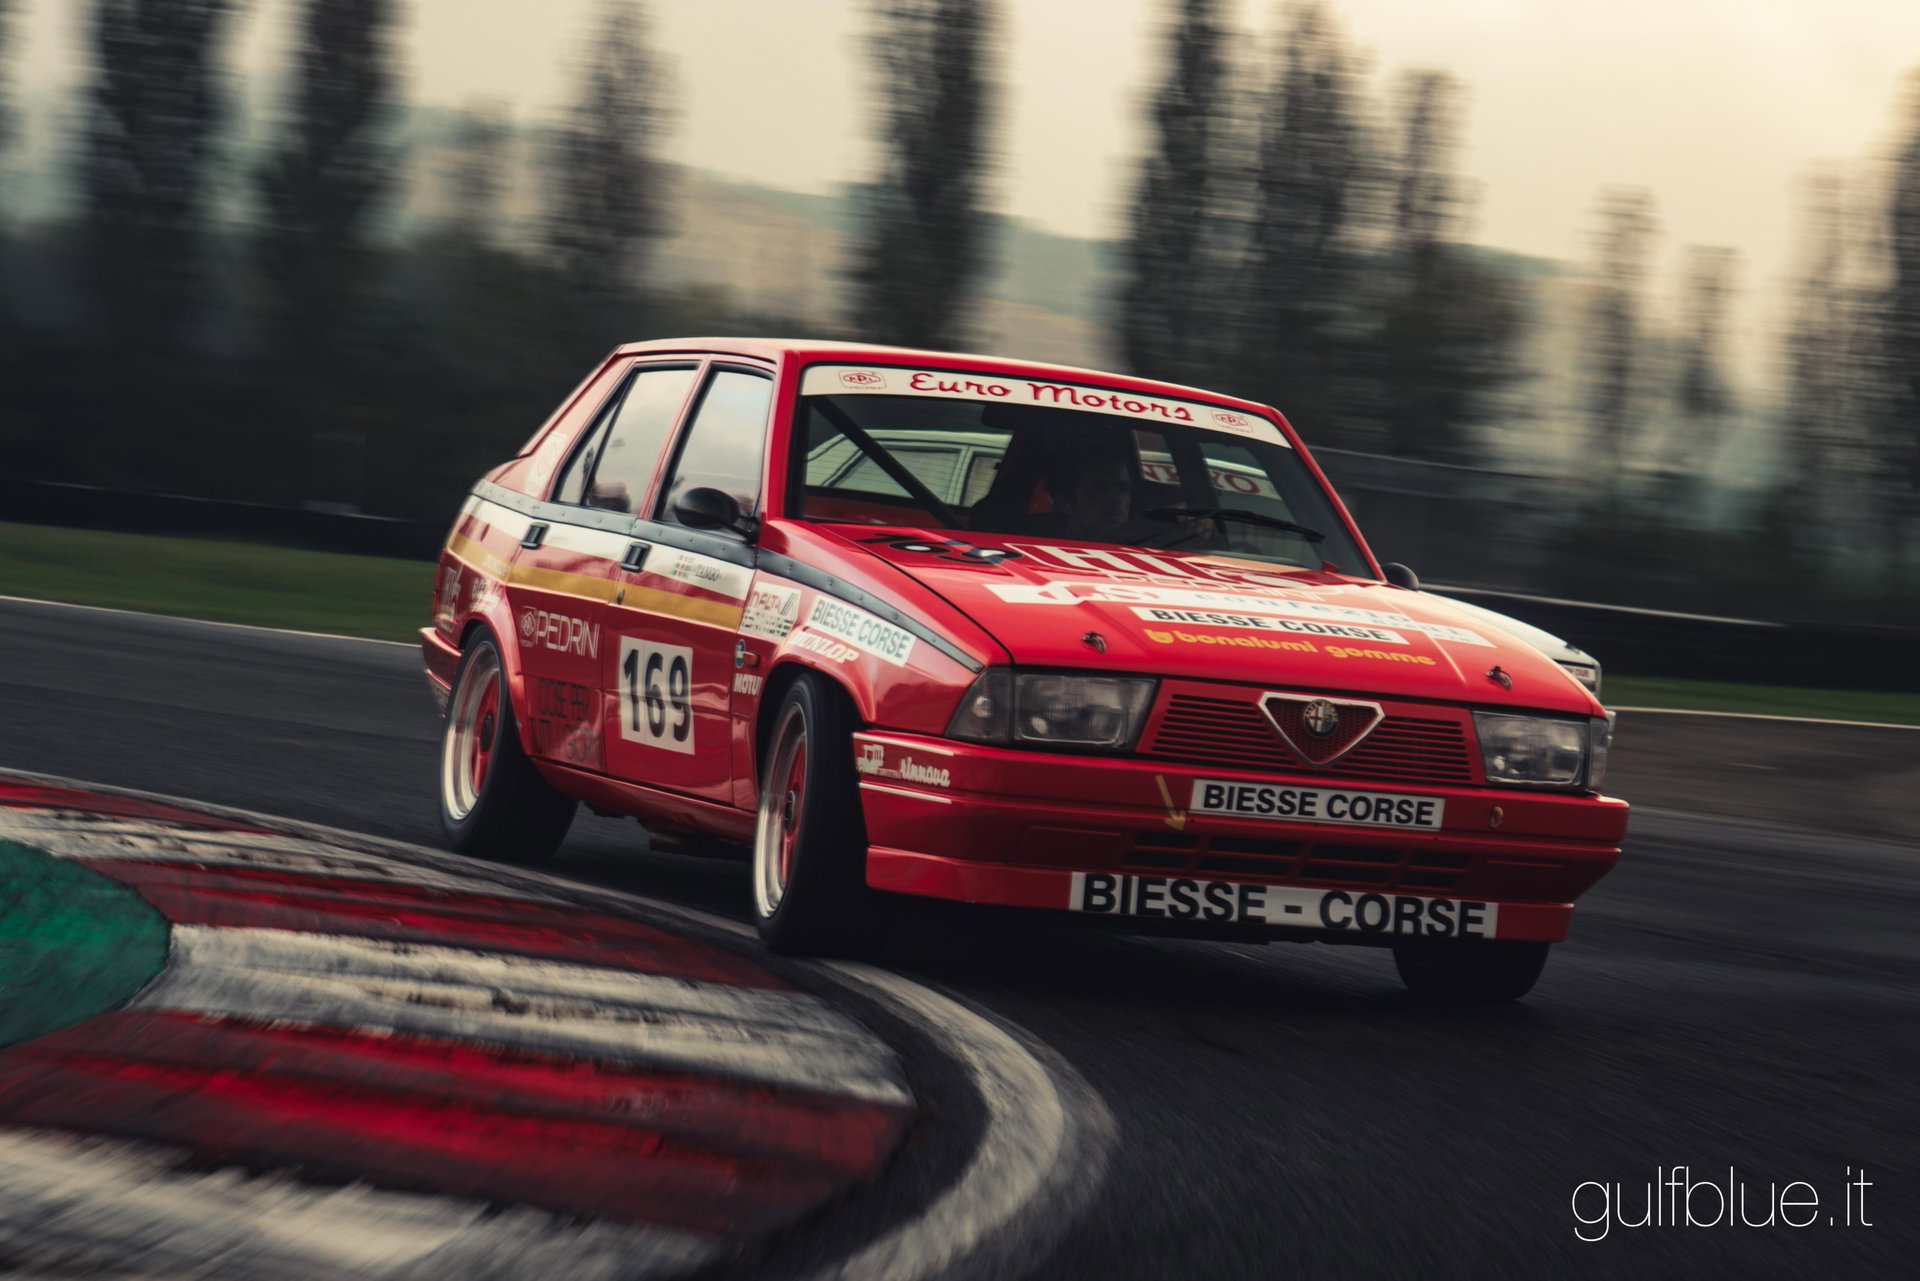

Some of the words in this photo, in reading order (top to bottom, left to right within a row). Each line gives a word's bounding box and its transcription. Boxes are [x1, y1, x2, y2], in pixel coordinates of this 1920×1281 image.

[909, 372, 1012, 397] Euro
[1027, 382, 1196, 422] Motors
[536, 610, 601, 659] PEDRINI
[811, 599, 858, 636] BIESSE
[857, 618, 911, 660] CORSE
[1149, 608, 1266, 630] BIESSE
[1277, 618, 1395, 642] CORSE
[1173, 629, 1319, 653] bonalumi
[1325, 644, 1437, 666] gomme
[623, 648, 691, 742] 169
[1202, 784, 1319, 817] BIESSE
[1326, 794, 1436, 826] CORSE
[1082, 872, 1268, 924] BIESSE
[1319, 889, 1487, 938] CORSE
